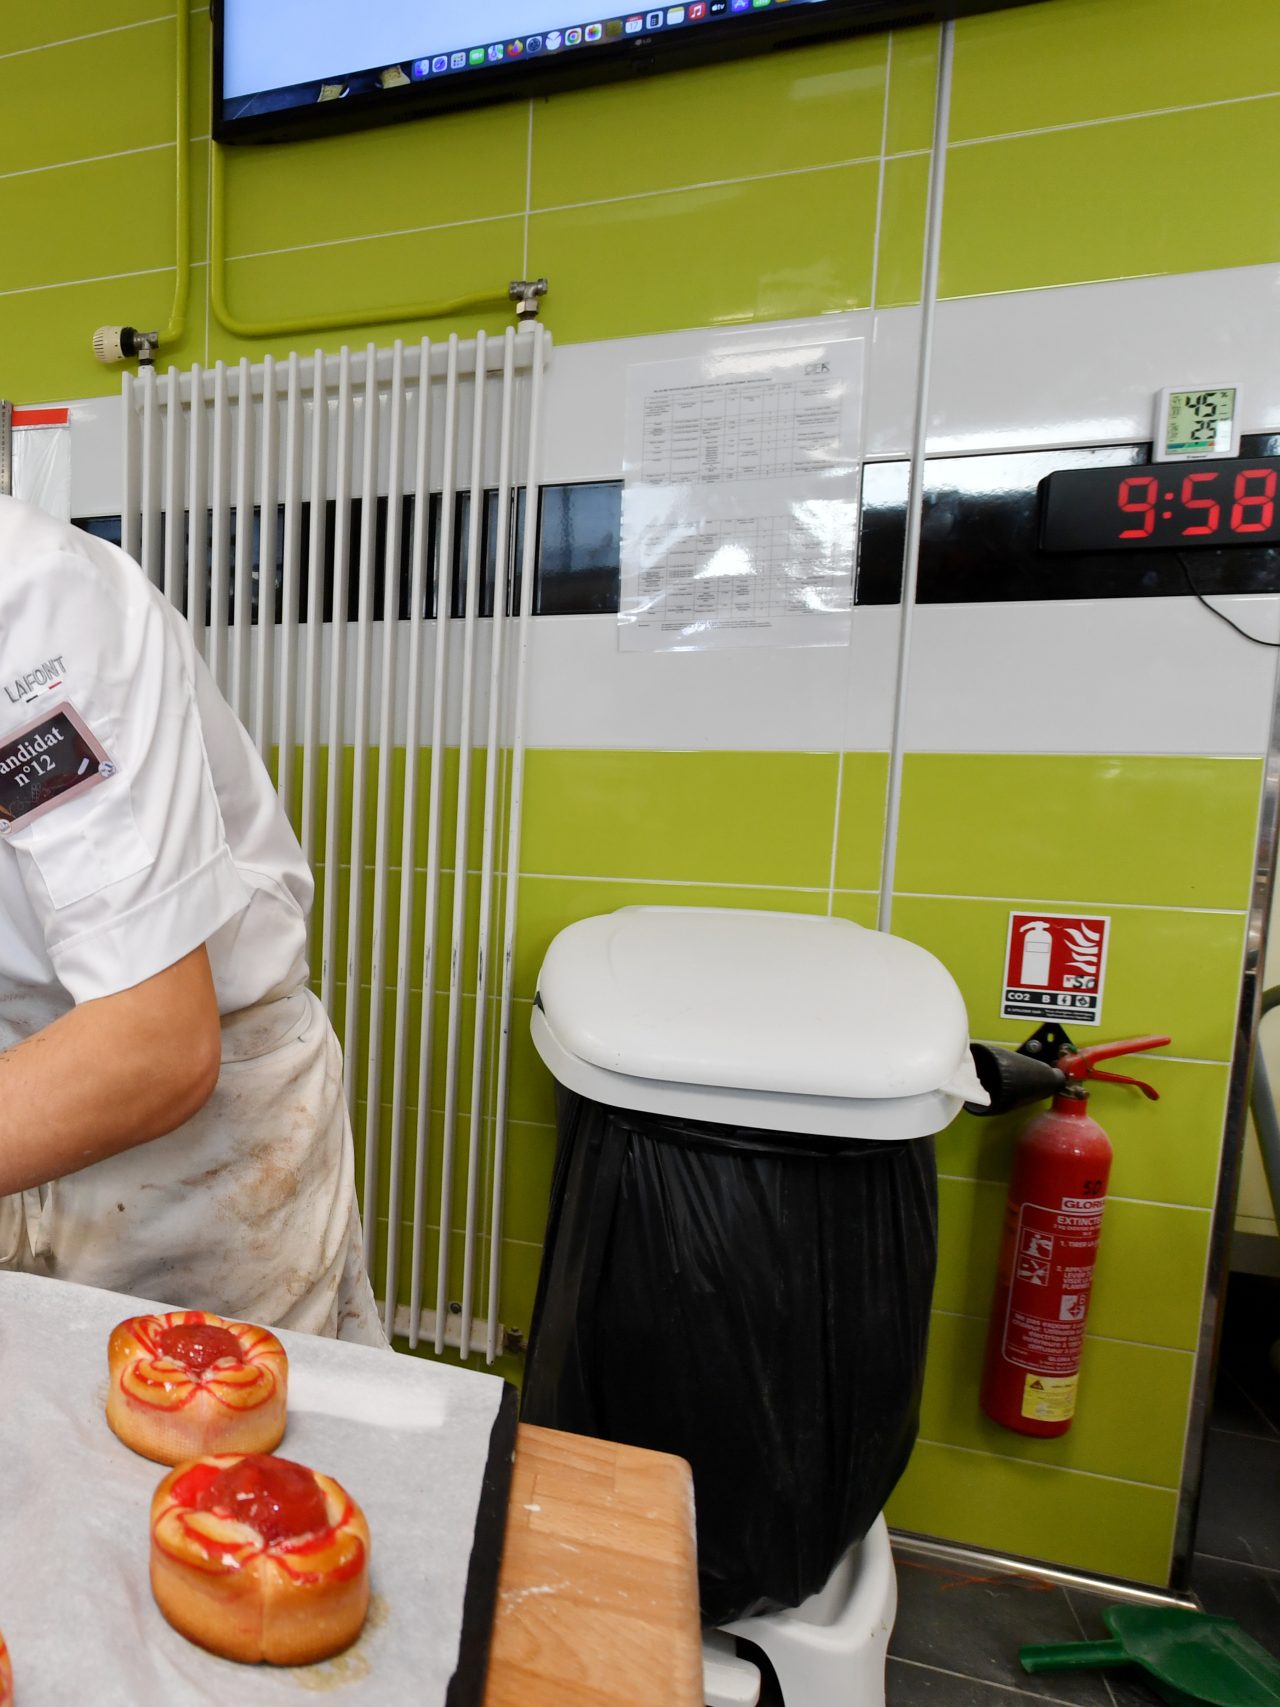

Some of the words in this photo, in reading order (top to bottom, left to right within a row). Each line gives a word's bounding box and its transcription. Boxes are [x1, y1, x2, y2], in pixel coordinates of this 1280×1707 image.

[1185, 392, 1218, 418] 45
[1190, 419, 1218, 440] 25
[1117, 468, 1278, 539] 9:58
[3, 656, 67, 704] LAFONT
[14, 754, 56, 788] n°12
[1007, 992, 1031, 1001] CO2
[1042, 994, 1051, 1003] B
